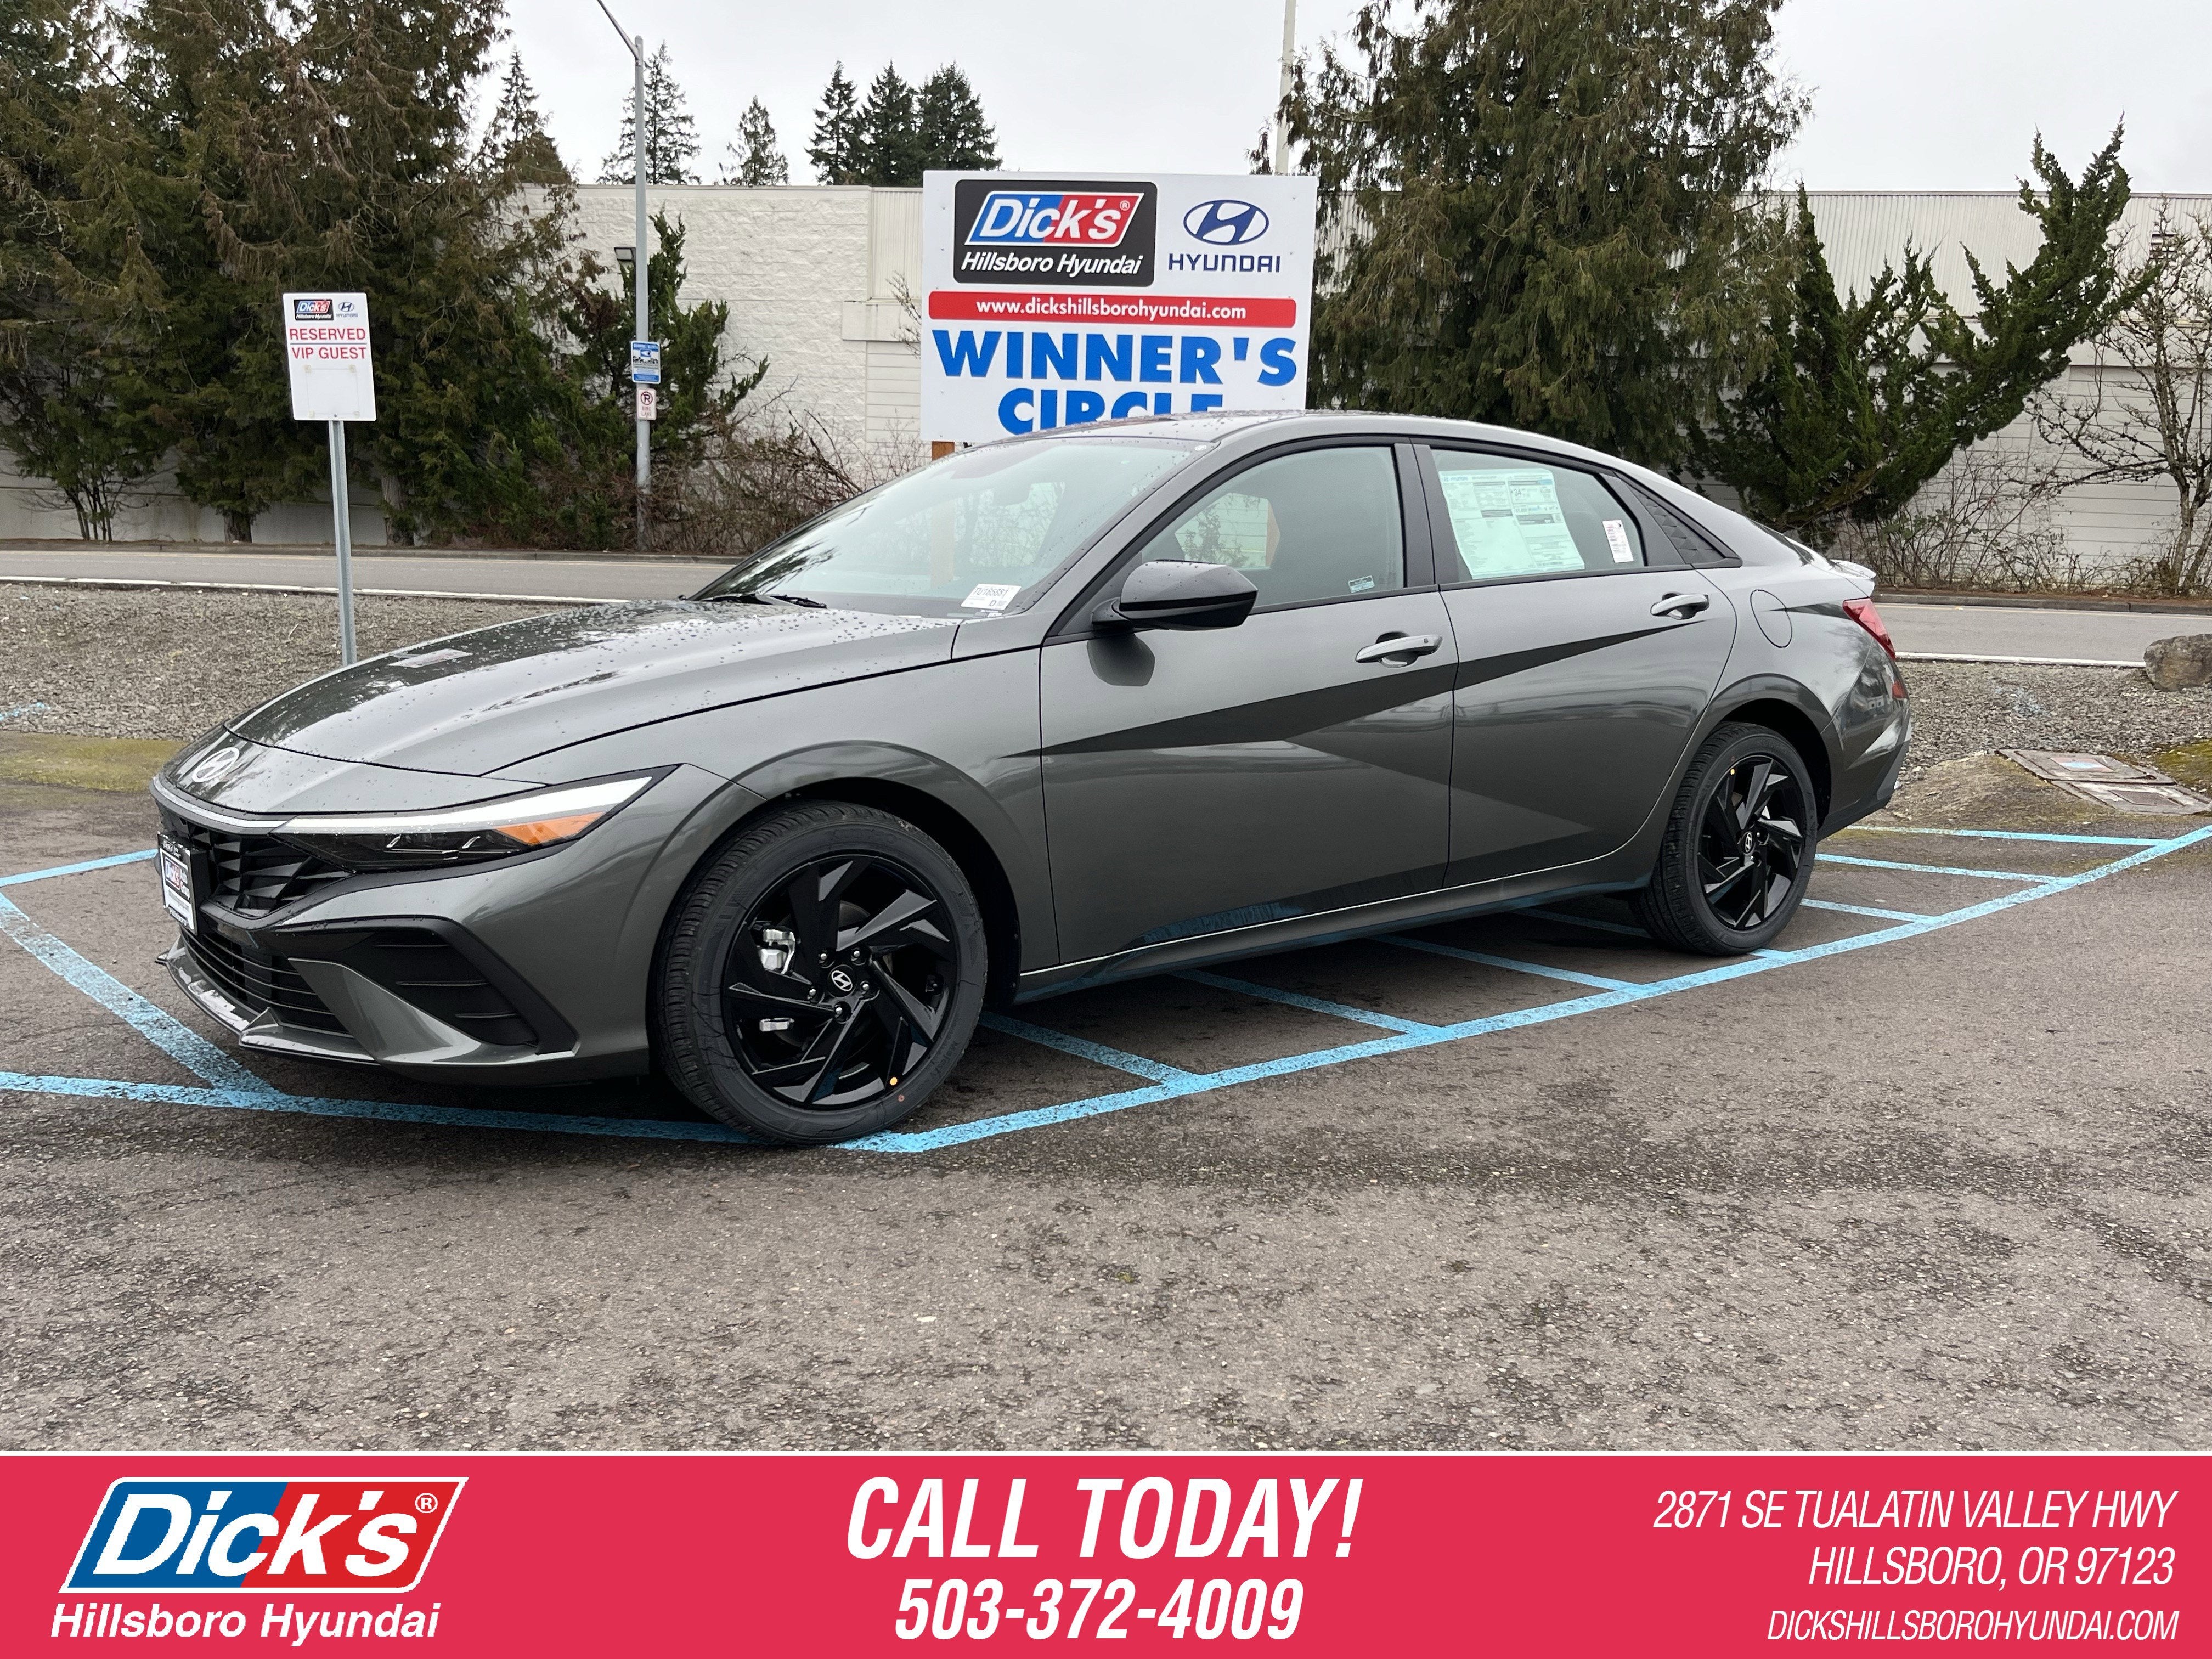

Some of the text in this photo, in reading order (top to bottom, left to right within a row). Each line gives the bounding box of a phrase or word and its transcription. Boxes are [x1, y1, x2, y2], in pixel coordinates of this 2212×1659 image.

[979, 198, 1121, 240] Dick's
[961, 251, 1144, 278] Hillsboro Hyundai
[1169, 253, 1280, 273] HYUNDAI
[299, 301, 328, 313] Dick's
[976, 296, 1246, 321] www.dickshillsborohyundai.com
[289, 328, 366, 340] RESERVED
[291, 347, 367, 359] VIP GUEST
[932, 329, 1297, 386] WINNER'S
